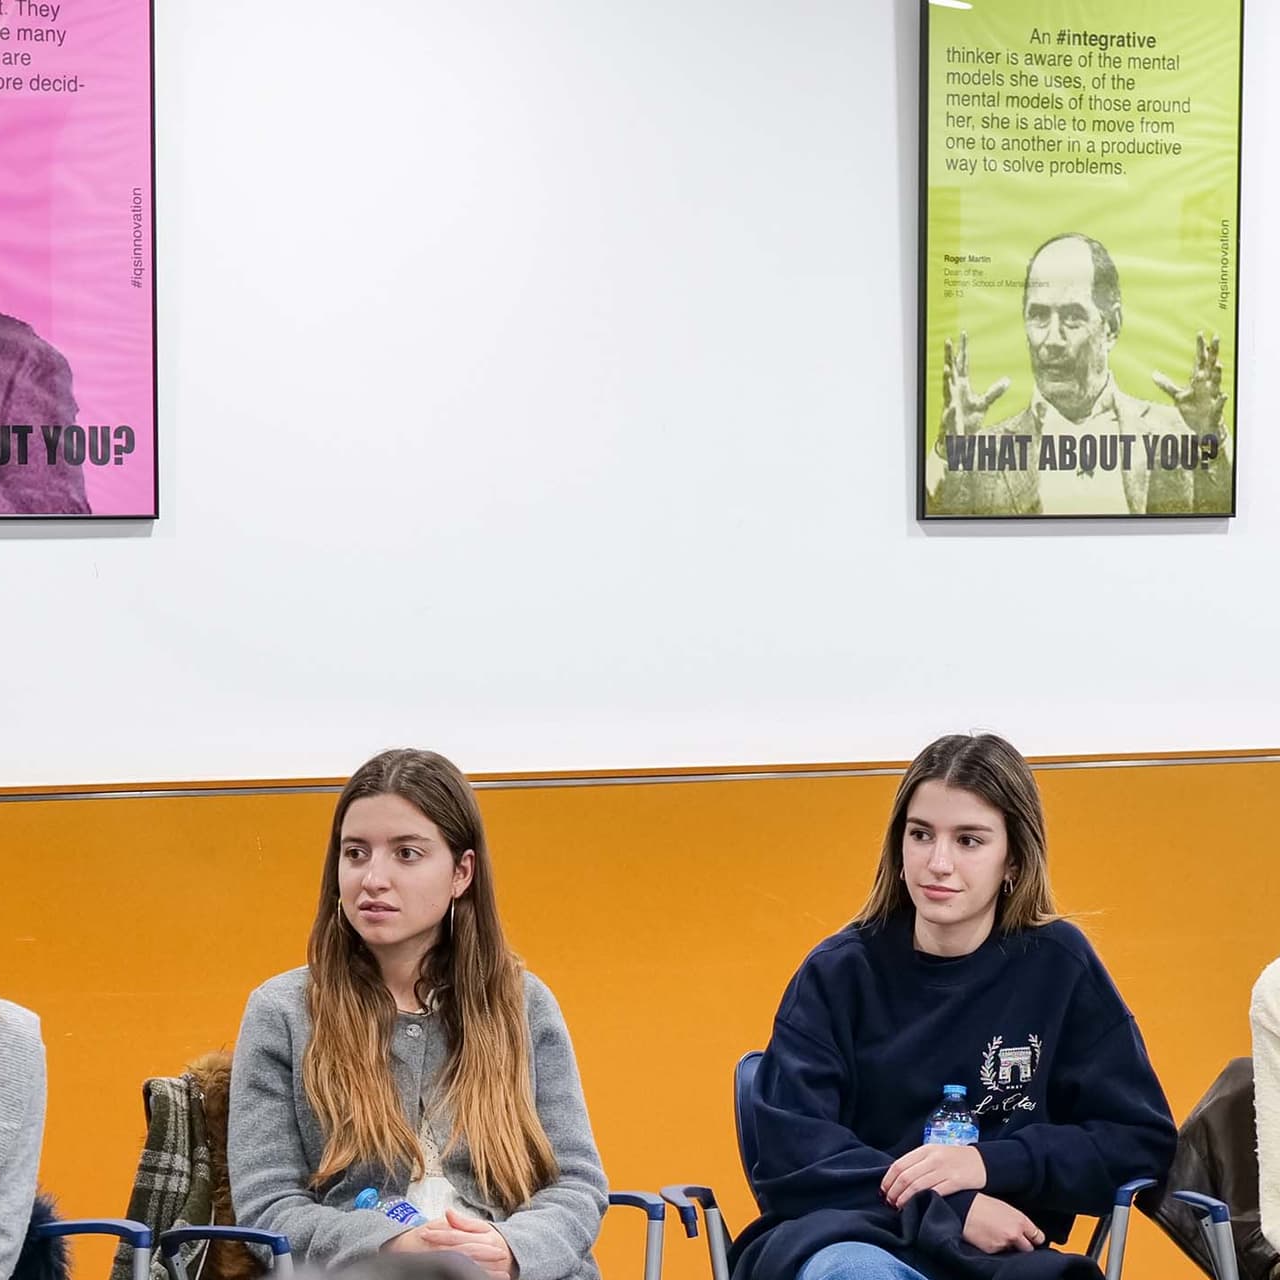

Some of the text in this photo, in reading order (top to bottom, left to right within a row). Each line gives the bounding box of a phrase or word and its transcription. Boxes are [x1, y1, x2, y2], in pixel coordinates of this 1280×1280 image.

[16, 0, 60, 22] They
[17, 26, 66, 46] many
[1030, 28, 1157, 51] An #integrative
[2, 51, 31, 66] are
[946, 47, 1180, 71] thinker is aware of the mental
[29, 75, 85, 92] decid-
[946, 69, 1135, 91] models she uses, of the
[946, 91, 1191, 113] mental models of those around
[946, 113, 1175, 134] her, she is able to move from
[946, 135, 1182, 157] one to another in a productive
[946, 156, 1127, 177] way to solve problems.
[130, 187, 145, 288] #iqsinnovation
[944, 254, 966, 264] Roger
[1218, 219, 1231, 310] #iqsinnovation
[39, 425, 135, 466] YOU?
[945, 434, 1218, 471] WHAT ABOUT YOU?
